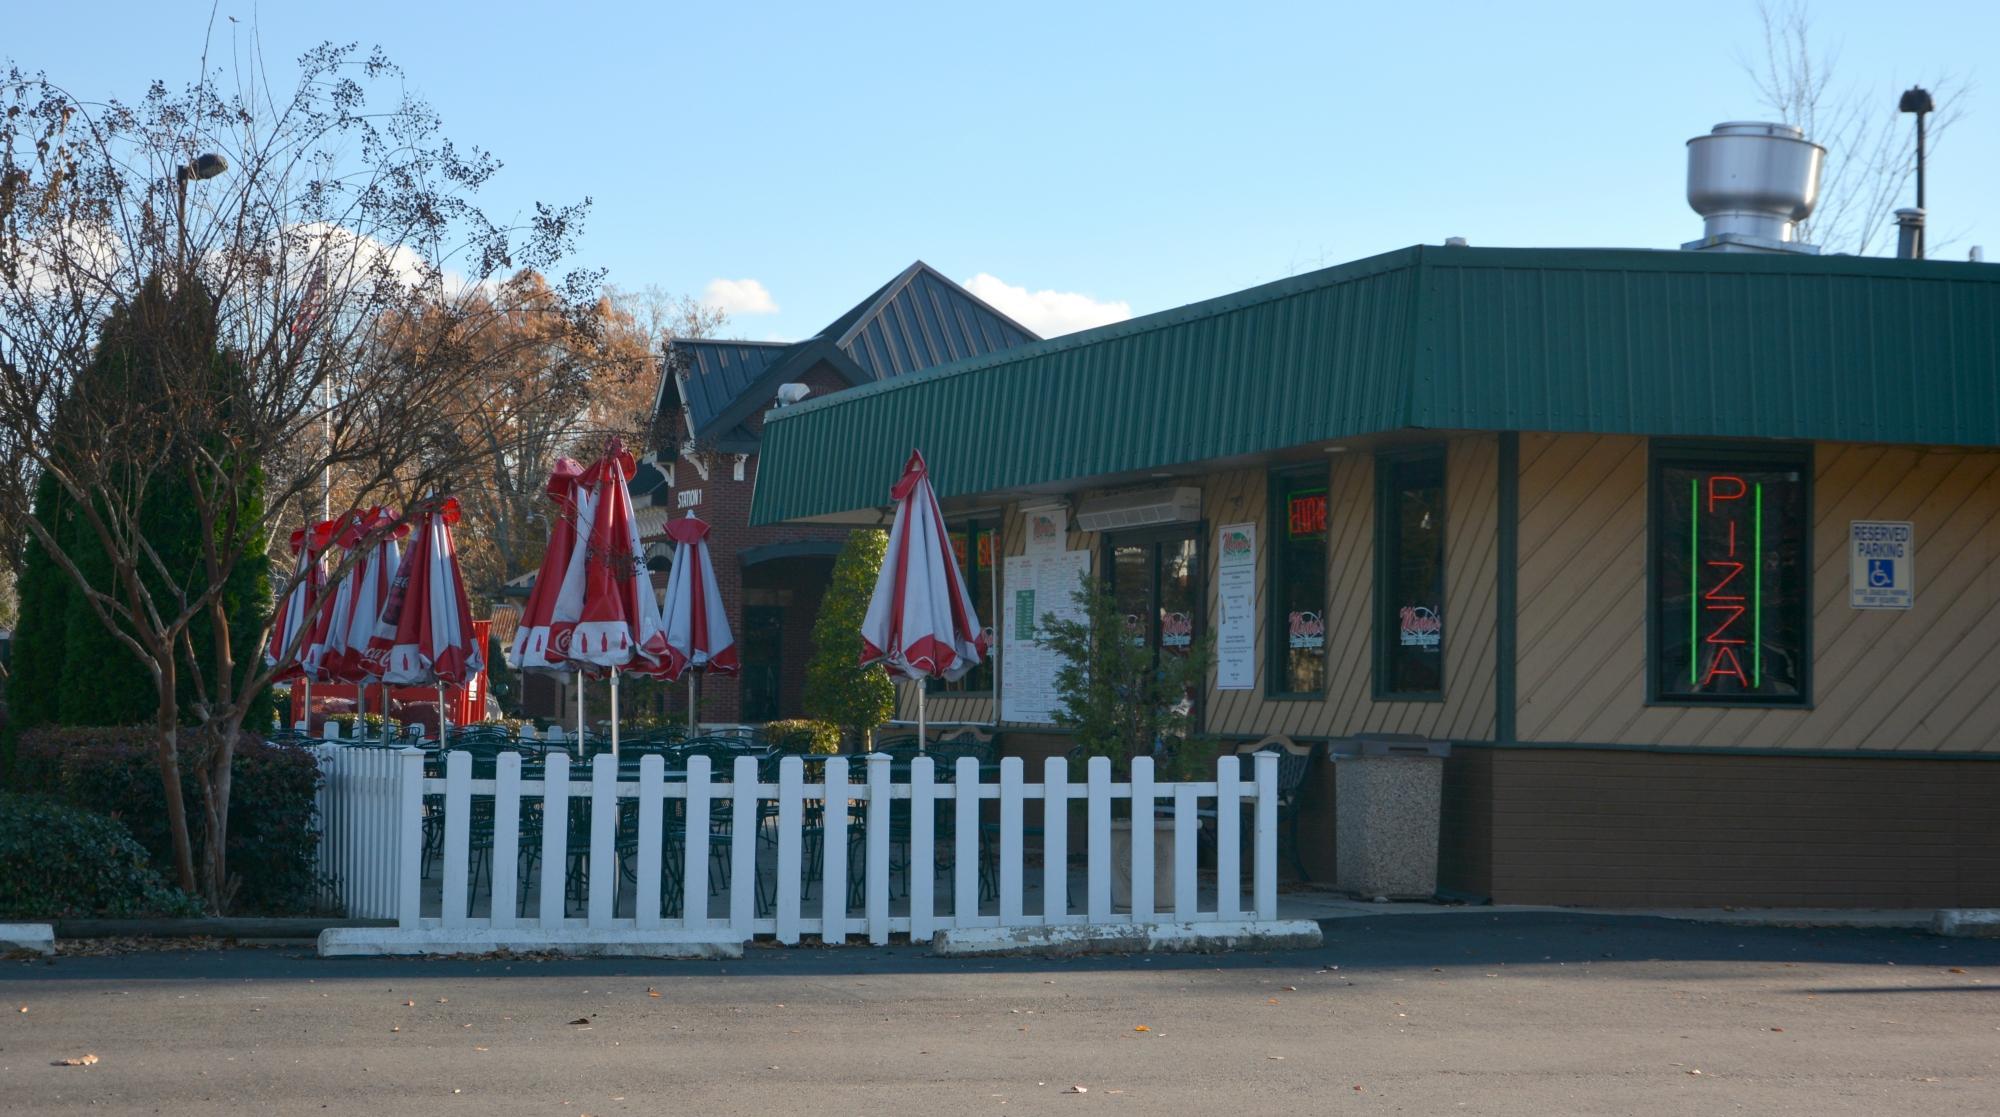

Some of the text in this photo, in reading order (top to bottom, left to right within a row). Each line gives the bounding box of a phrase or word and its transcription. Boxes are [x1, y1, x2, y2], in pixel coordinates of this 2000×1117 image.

[677, 489, 698, 508] STATION
[1854, 526, 1908, 542] RESERVED
[1858, 543, 1904, 558] PARKING
[1704, 475, 1748, 688] PIZZA
